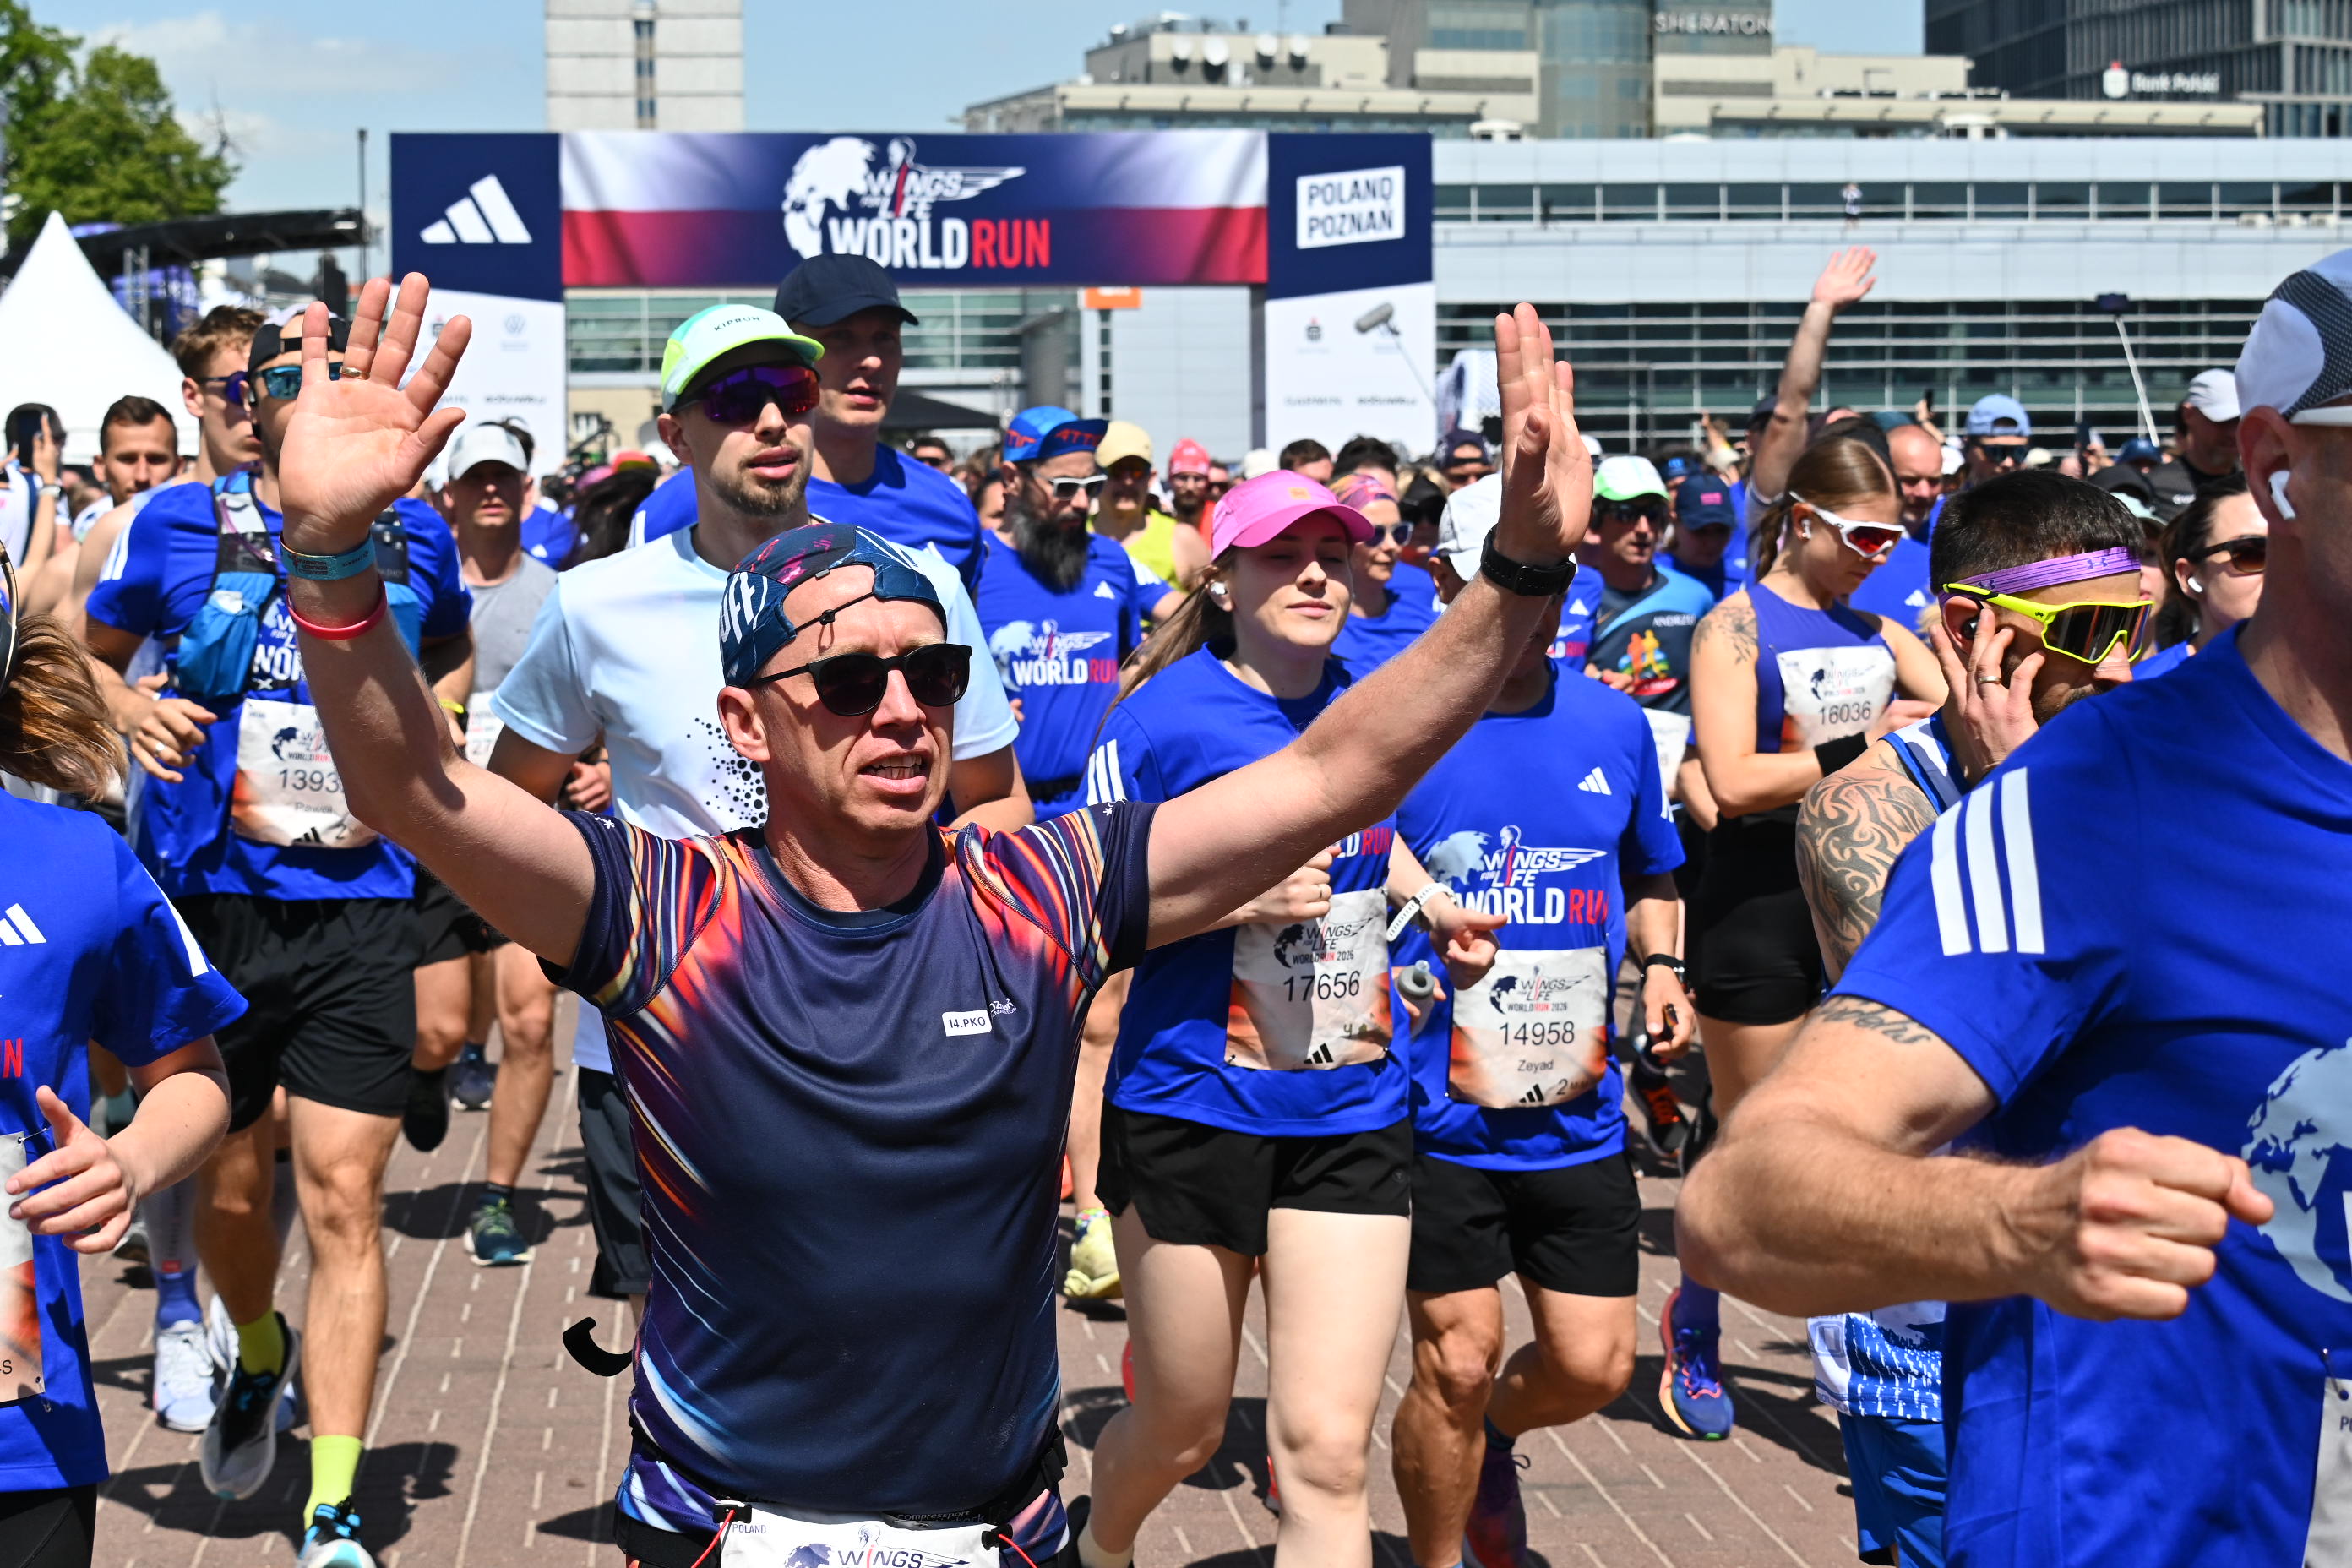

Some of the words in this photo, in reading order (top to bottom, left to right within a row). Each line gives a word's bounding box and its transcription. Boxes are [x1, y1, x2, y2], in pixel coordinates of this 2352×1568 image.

[1655, 12, 1775, 35] SHERATON
[2132, 72, 2170, 93] Bank
[2172, 72, 2219, 94] Polski
[867, 170, 965, 198] WINGS
[1309, 177, 1393, 207] POLAND
[876, 195, 934, 220] LIFE
[714, 316, 760, 331] KIPRUN
[1819, 700, 1871, 726] 16036
[280, 769, 344, 793] 1393
[1484, 851, 1561, 871] WINGS
[1491, 869, 1539, 888] LIFE
[1306, 923, 1352, 939] WINGS
[1311, 938, 1339, 951] LIFE
[1283, 971, 1360, 1002] 17656
[1521, 978, 1565, 991] WINGS
[947, 1016, 986, 1029] 14.PKO
[1500, 1021, 1576, 1046] 14958
[1517, 1059, 1554, 1074] Zeyad
[897, 1510, 971, 1522] Compressport
[732, 1523, 766, 1534] POLAND
[837, 1550, 924, 1568] WINGS
